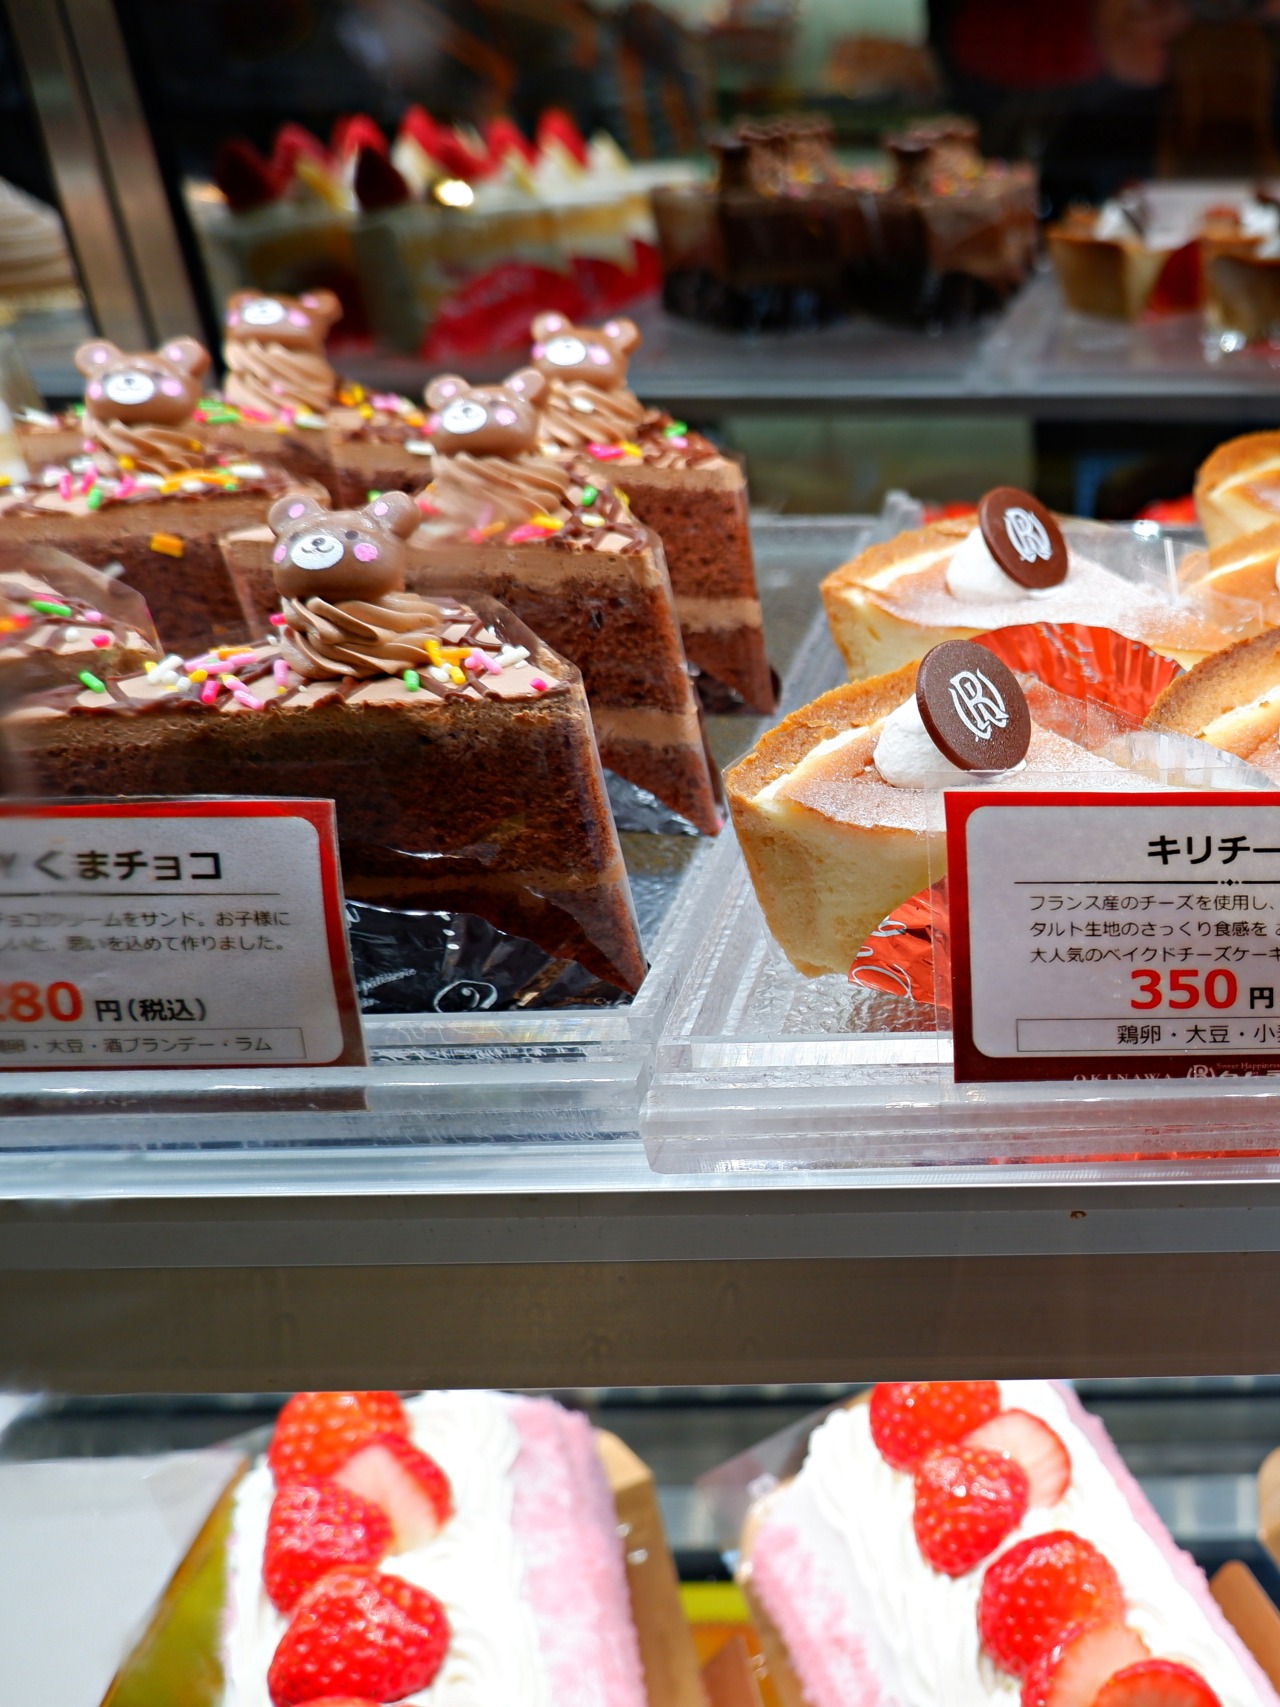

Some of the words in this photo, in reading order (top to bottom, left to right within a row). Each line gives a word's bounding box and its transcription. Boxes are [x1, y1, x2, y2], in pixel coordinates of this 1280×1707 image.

[34, 849, 223, 881] くまチョコ
[0, 980, 83, 1023] 80
[1130, 968, 1239, 1011] 350
